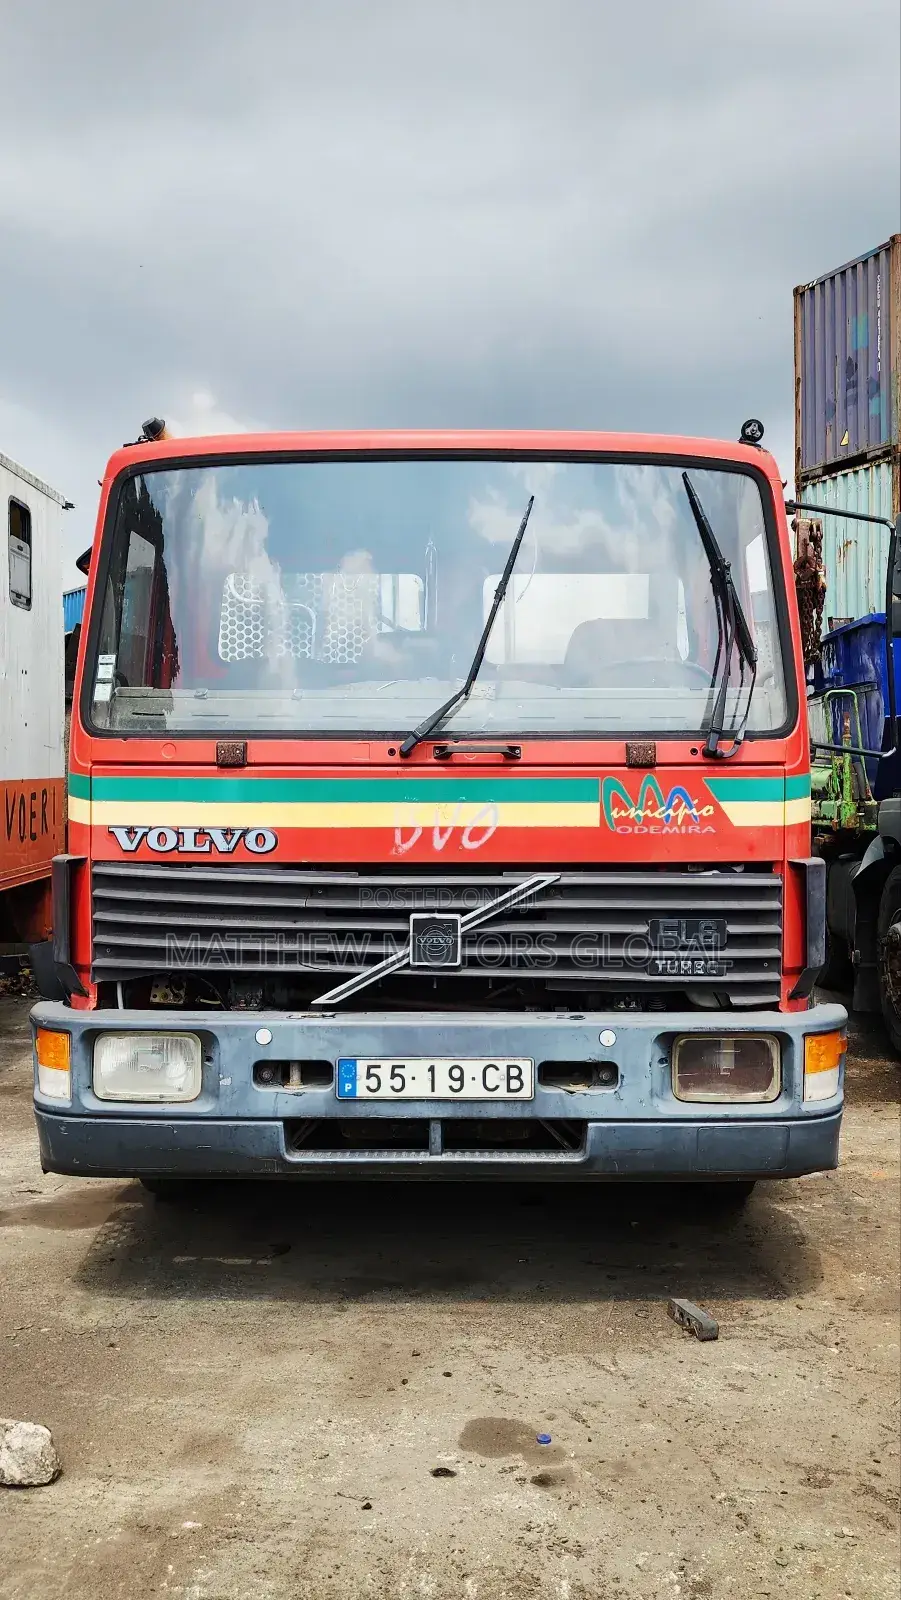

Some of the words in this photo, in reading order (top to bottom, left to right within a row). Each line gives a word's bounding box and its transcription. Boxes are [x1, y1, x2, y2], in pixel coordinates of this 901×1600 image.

[616, 825, 716, 834] ODEMIRA
[108, 826, 278, 854] VOLVO
[655, 960, 719, 975] TURBO
[344, 1083, 352, 1093] P
